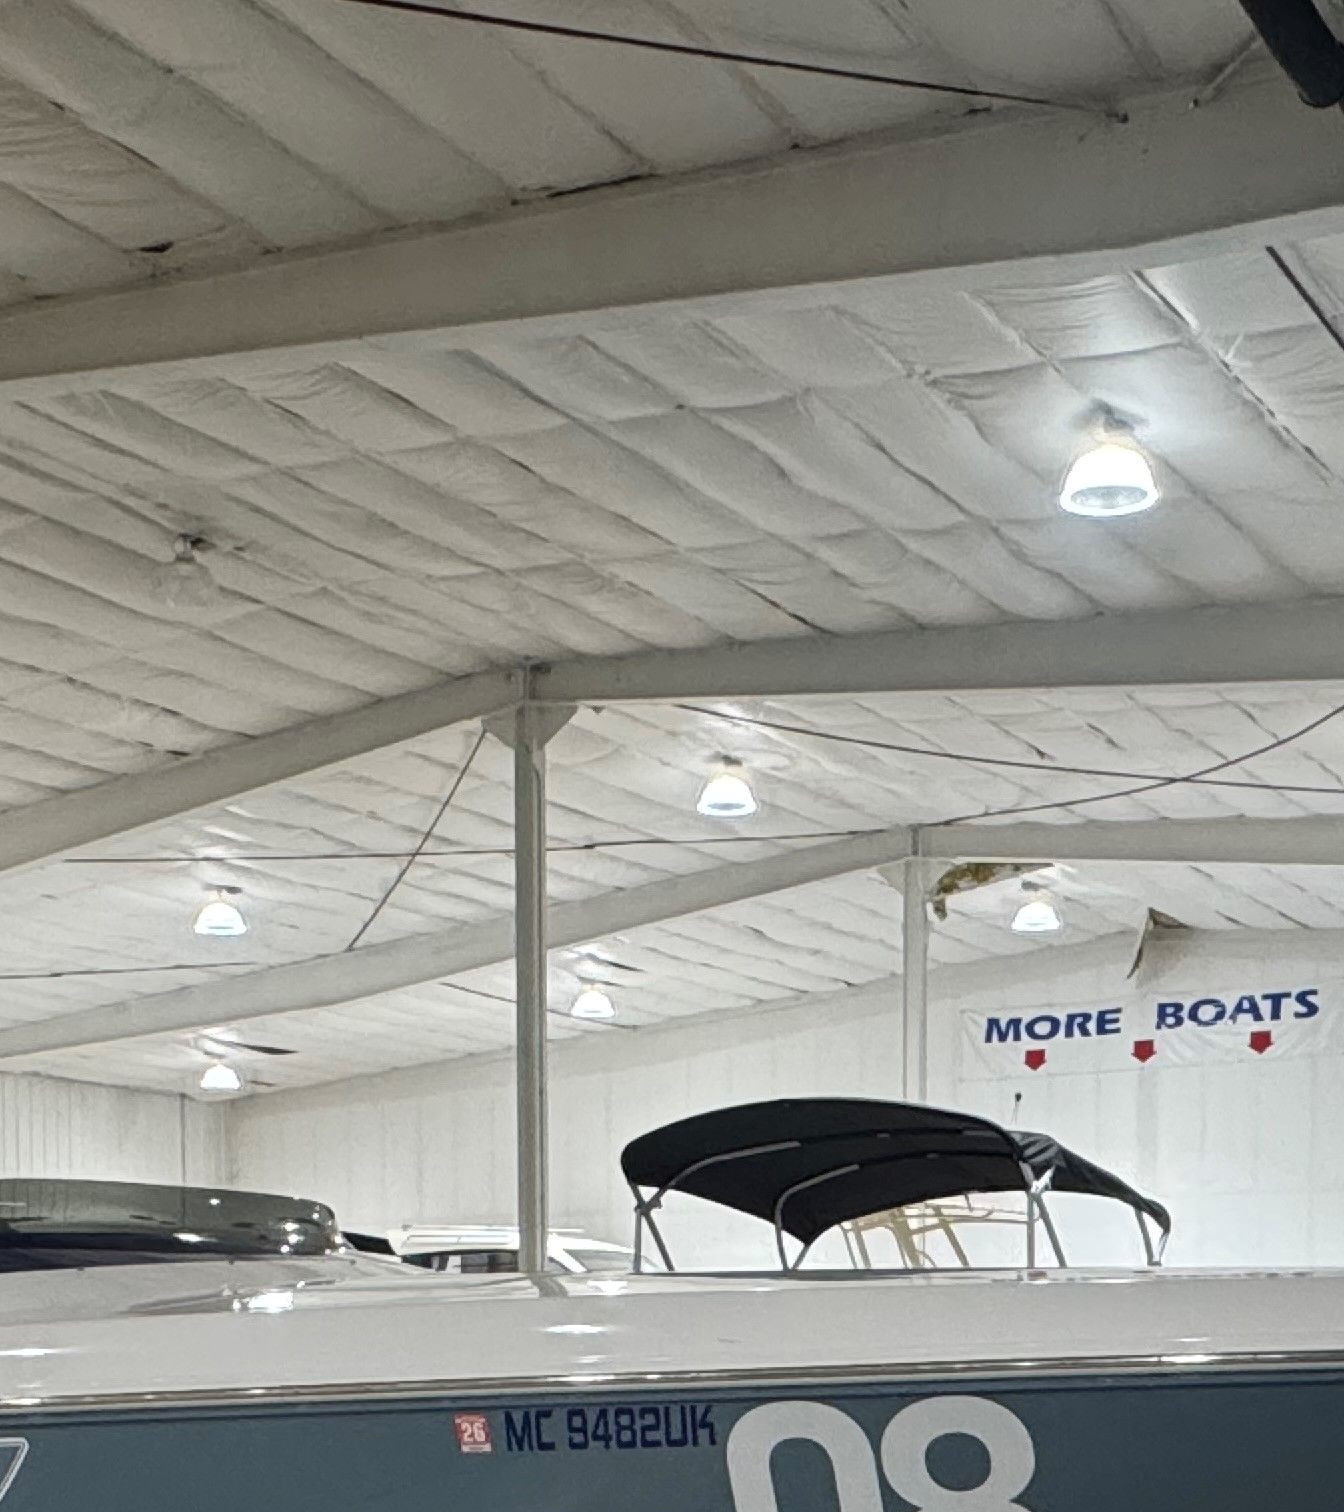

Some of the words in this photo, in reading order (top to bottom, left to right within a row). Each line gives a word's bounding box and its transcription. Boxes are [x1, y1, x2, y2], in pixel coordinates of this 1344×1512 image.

[984, 1007, 1123, 1044] MORE
[1155, 988, 1320, 1030] BOATS
[460, 1422, 486, 1442] 26
[504, 1409, 556, 1452] MC
[567, 1404, 718, 1450] 9482UK
